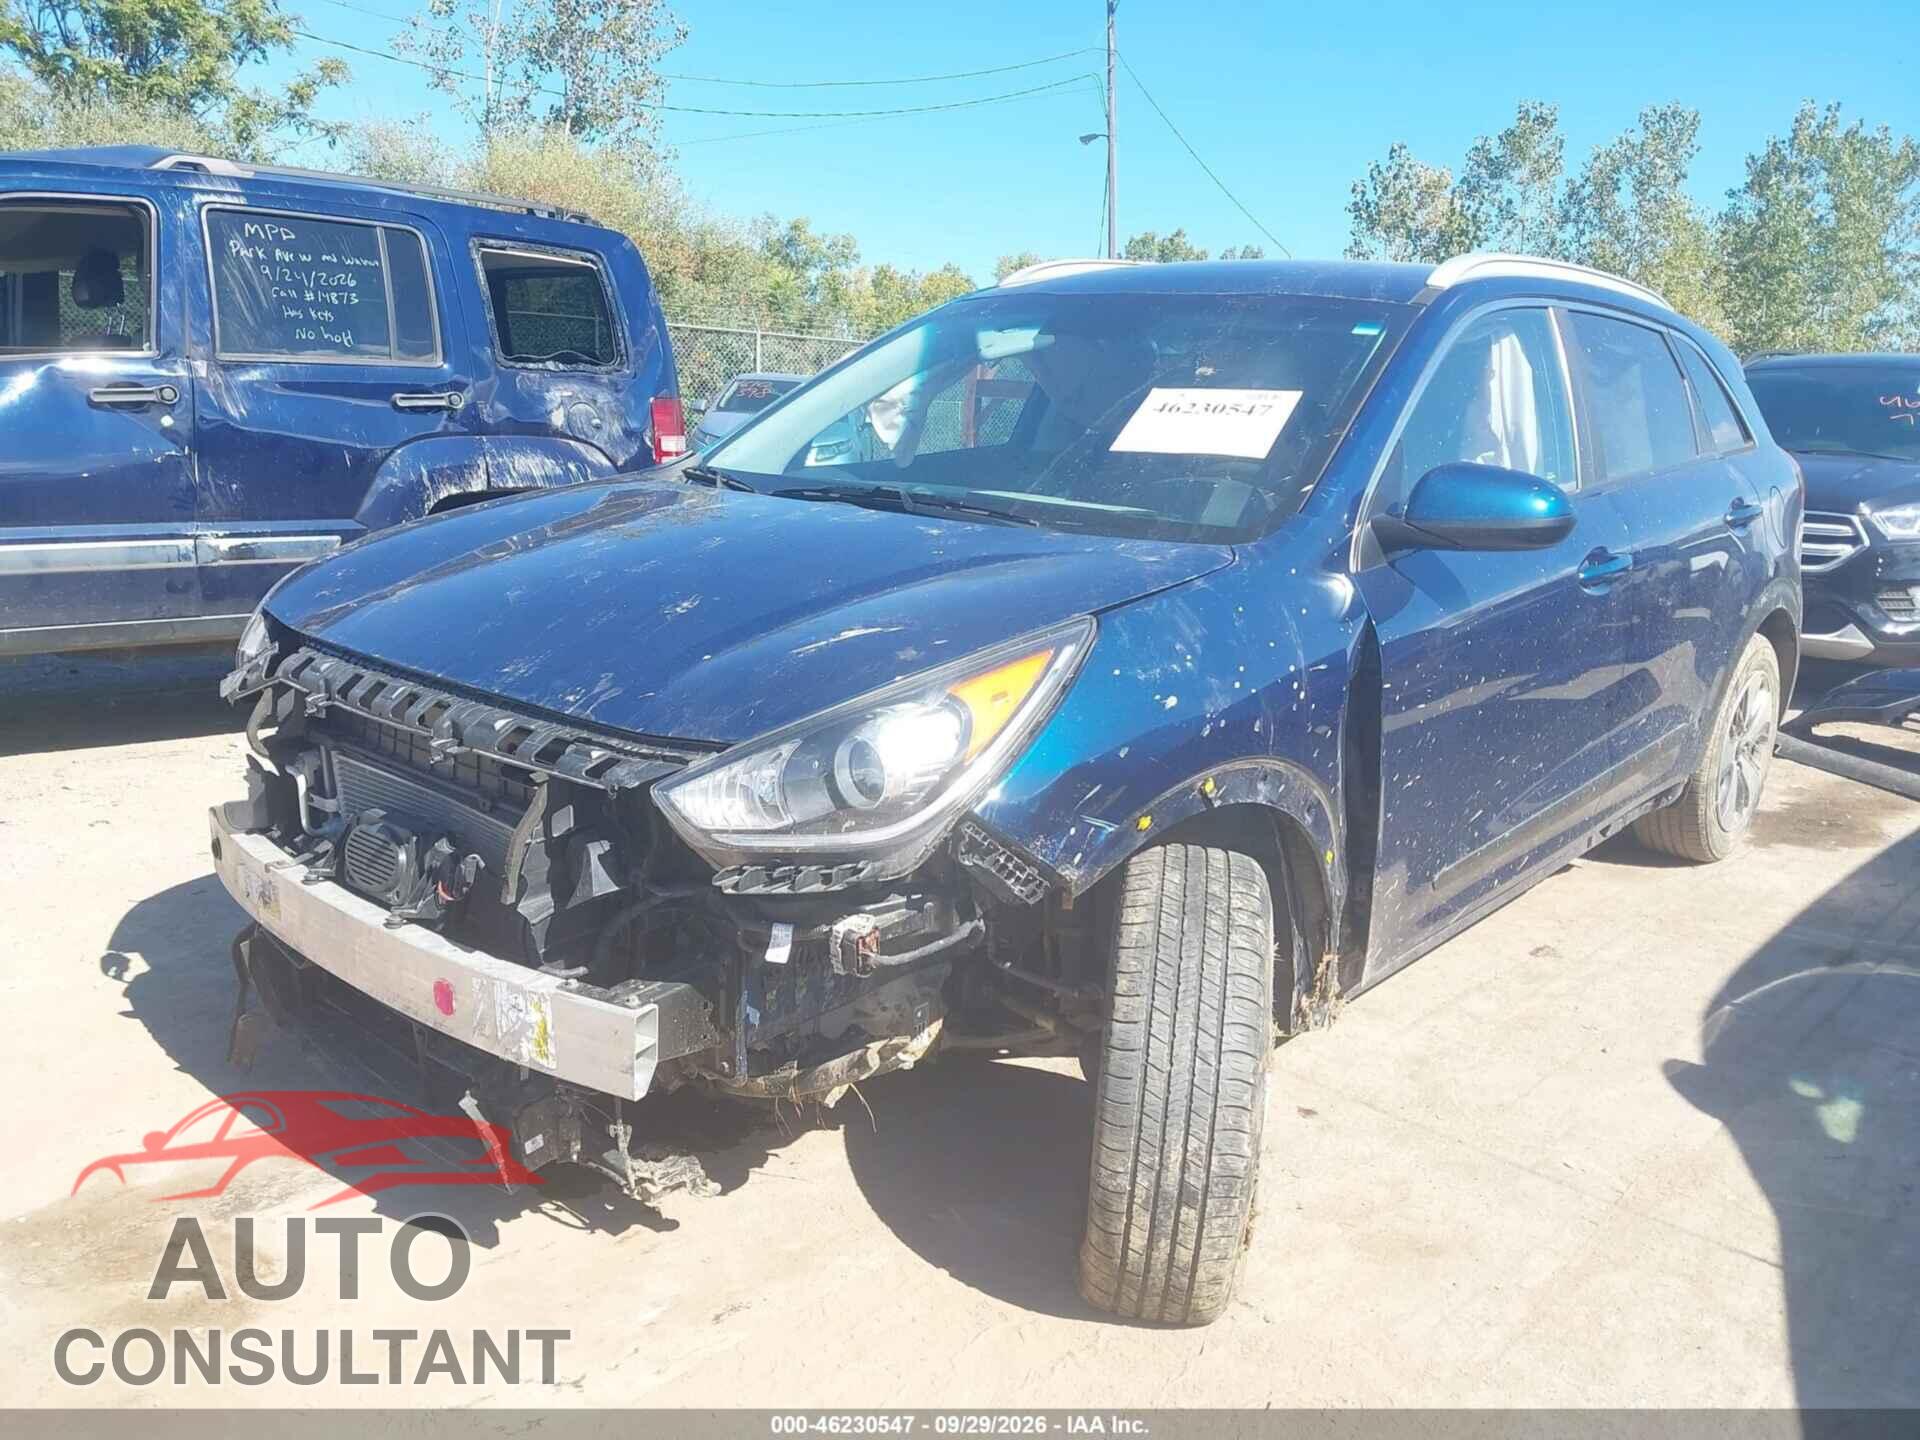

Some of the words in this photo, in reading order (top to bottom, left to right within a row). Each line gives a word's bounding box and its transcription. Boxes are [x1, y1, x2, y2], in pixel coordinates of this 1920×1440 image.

[244, 222, 296, 240] MPD
[229, 239, 267, 260] Park
[260, 264, 357, 288] 9/24/2026
[303, 289, 359, 305] #14873
[295, 327, 316, 340] No
[1152, 401, 1274, 417] 46230547
